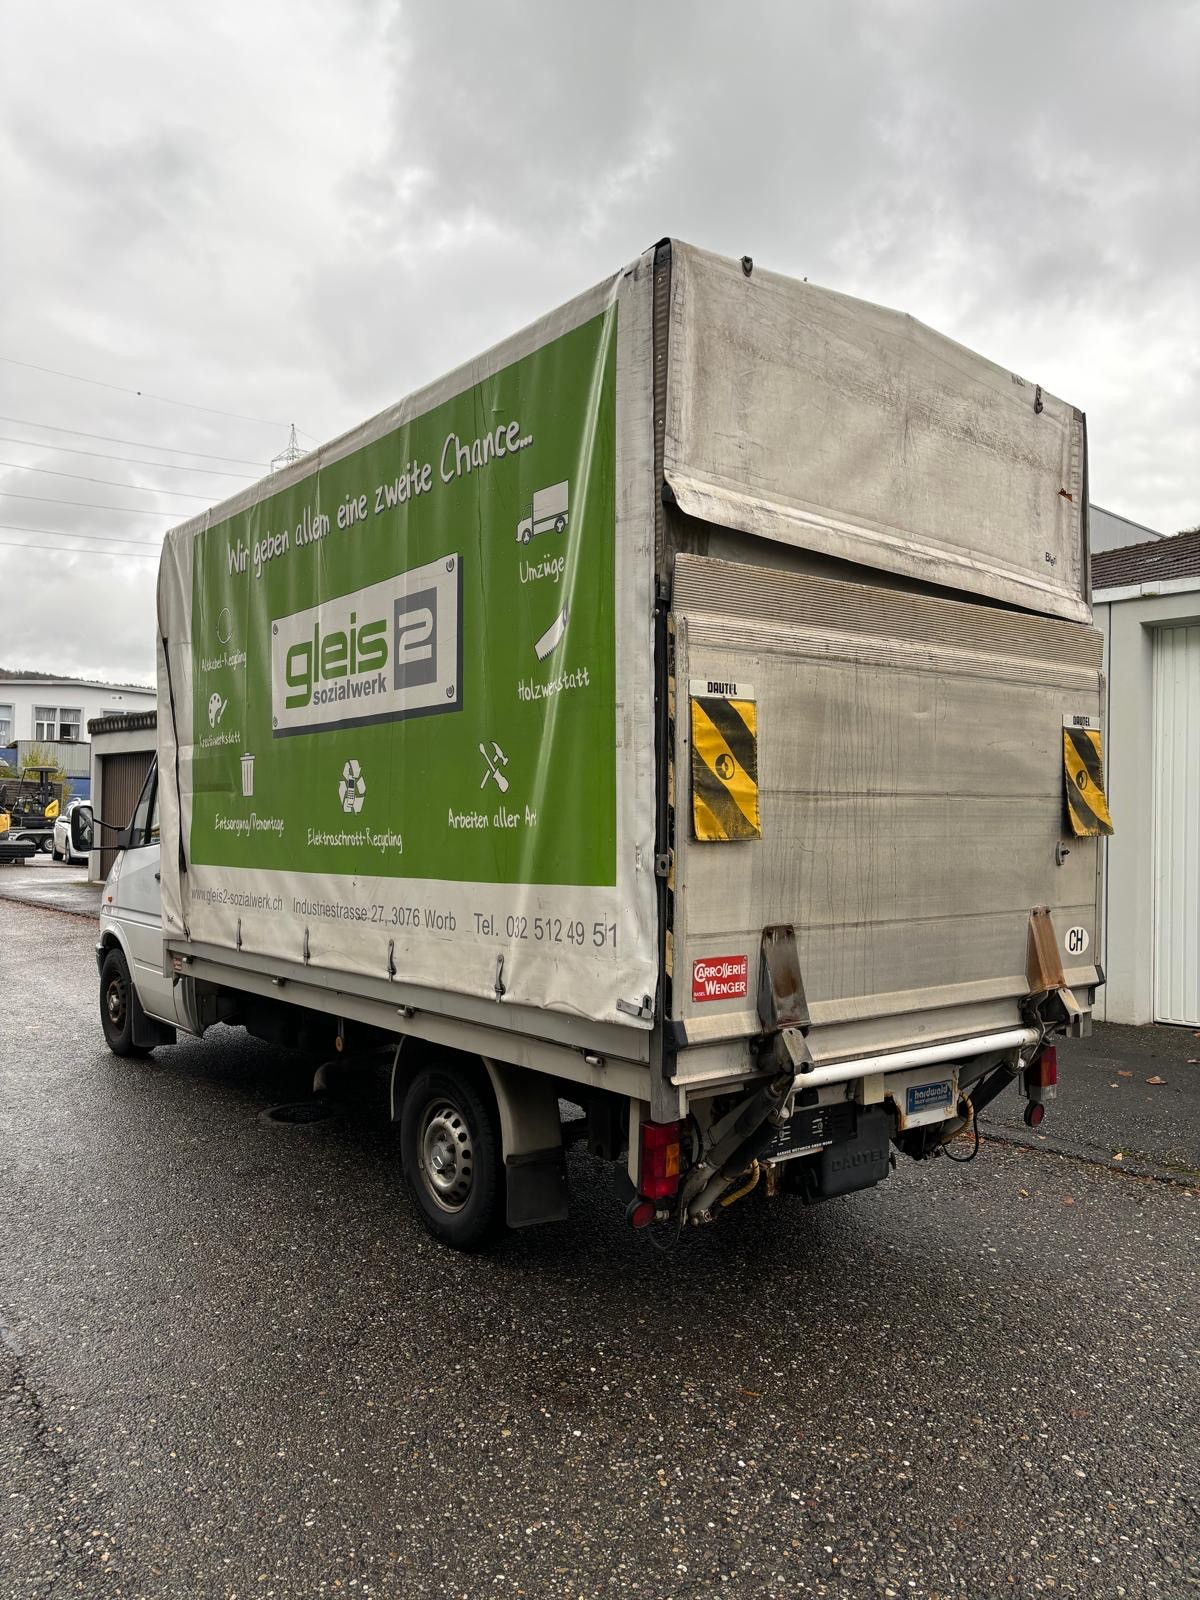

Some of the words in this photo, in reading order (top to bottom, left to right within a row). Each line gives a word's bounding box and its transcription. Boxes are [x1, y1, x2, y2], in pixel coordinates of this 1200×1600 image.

[227, 538, 250, 576] Wir
[253, 530, 290, 578] geben
[337, 494, 368, 529] eine
[374, 459, 433, 515] zweite
[440, 420, 533, 483] Chance...
[519, 553, 565, 584] Umzüge
[285, 611, 389, 710] gleis
[313, 672, 387, 706] sozialwerk
[707, 681, 738, 695] DAUTEL
[448, 807, 489, 829] Arbeiten
[493, 805, 520, 828] aller
[307, 827, 403, 854] Elektroschrott-Recycling
[391, 906, 420, 927] 3076
[424, 909, 457, 932] Worb
[473, 912, 499, 937] Tel.
[506, 915, 528, 940] 032
[533, 917, 563, 943] 512
[566, 920, 585, 946] 49
[592, 922, 617, 948] 51
[1069, 929, 1083, 951] CH
[705, 980, 746, 995] WENGER
[832, 1150, 887, 1172] DAUTEL
